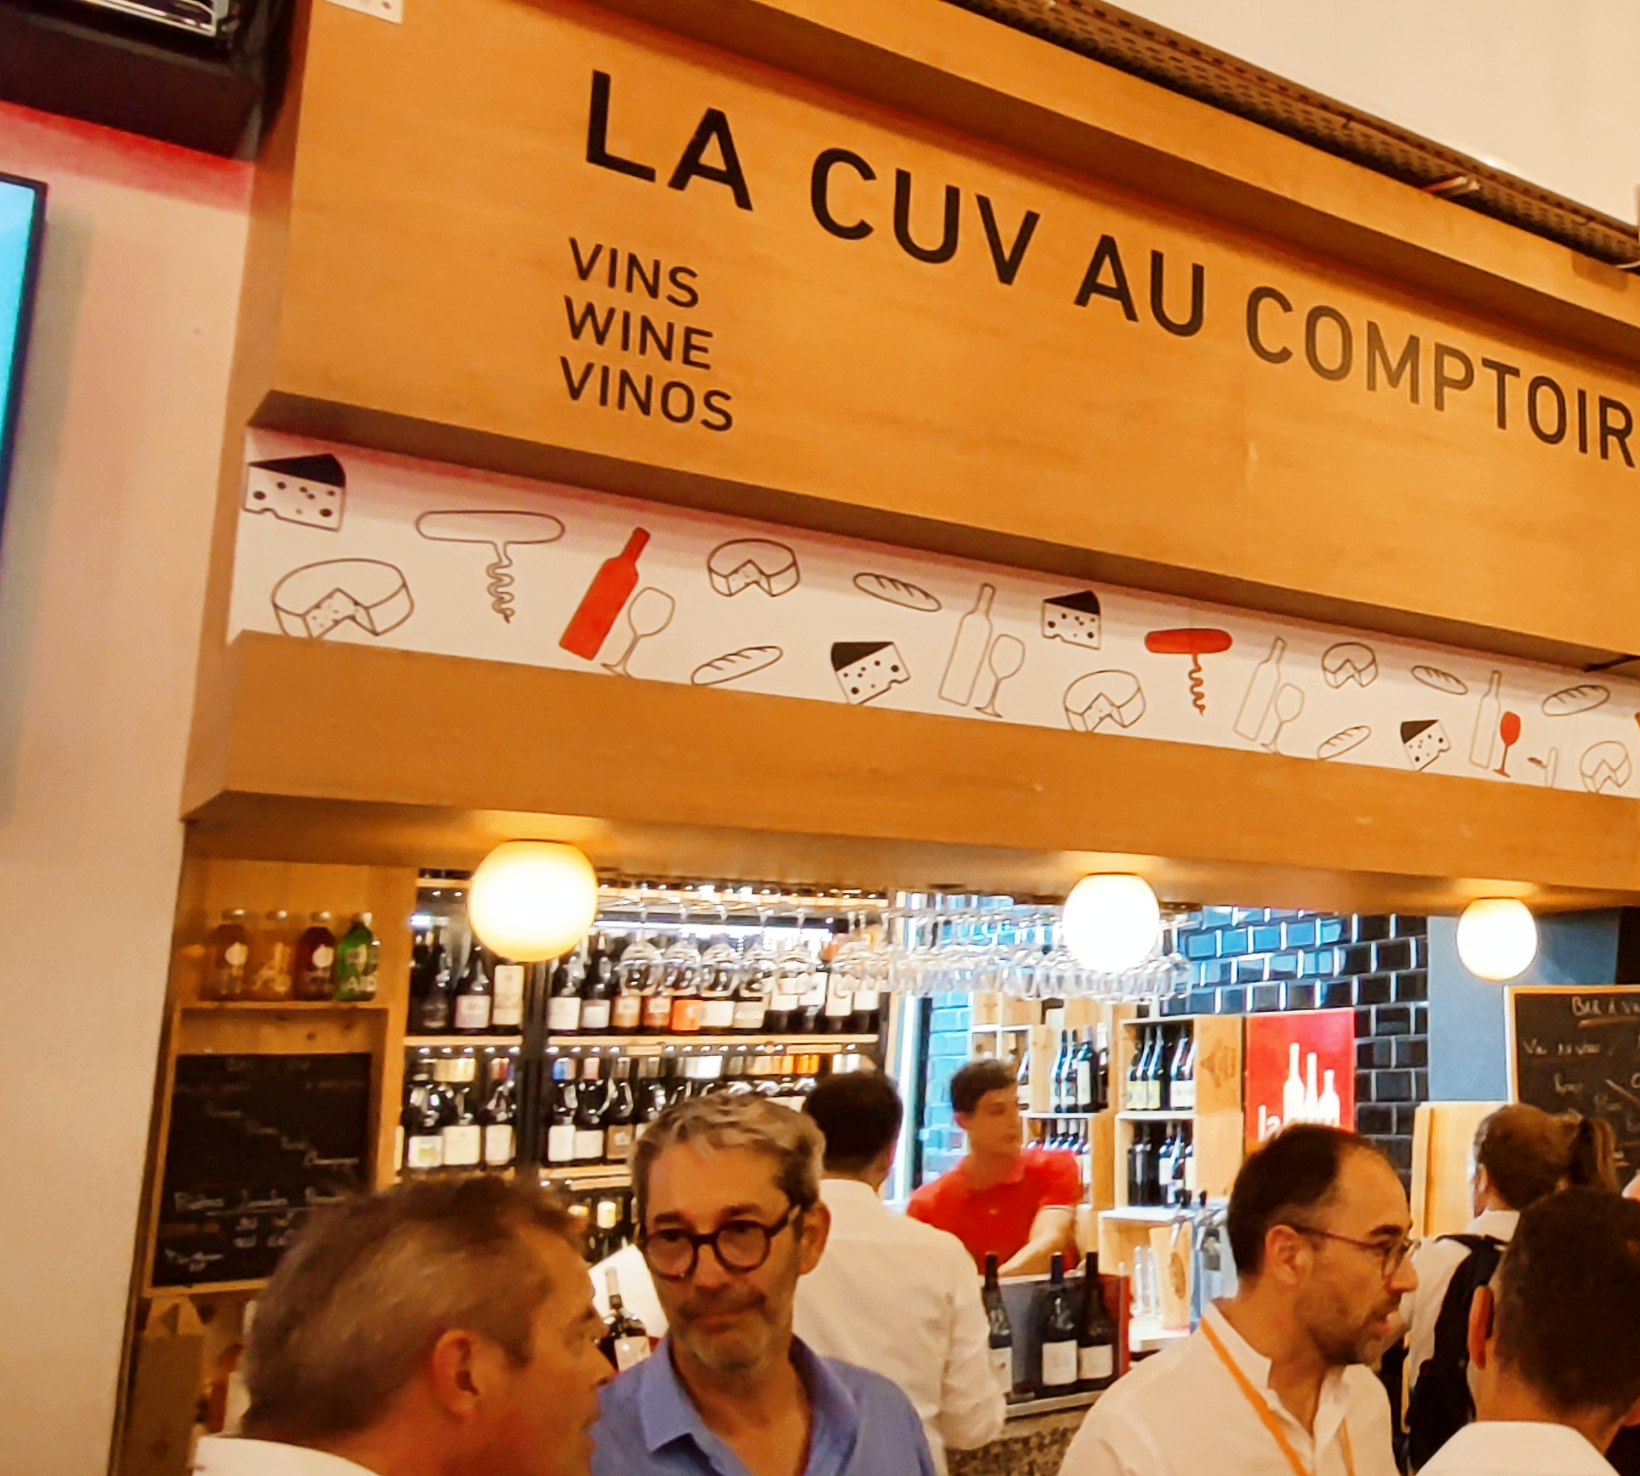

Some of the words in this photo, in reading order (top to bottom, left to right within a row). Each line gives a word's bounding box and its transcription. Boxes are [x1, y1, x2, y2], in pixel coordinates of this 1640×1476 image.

[568, 237, 700, 309] VINS
[586, 69, 753, 211] LA
[809, 147, 1040, 287] CUV
[1074, 234, 1206, 338] AU
[1246, 286, 1637, 468] COMPTOIR
[563, 295, 714, 370] WINE
[559, 355, 734, 433] VINOS
